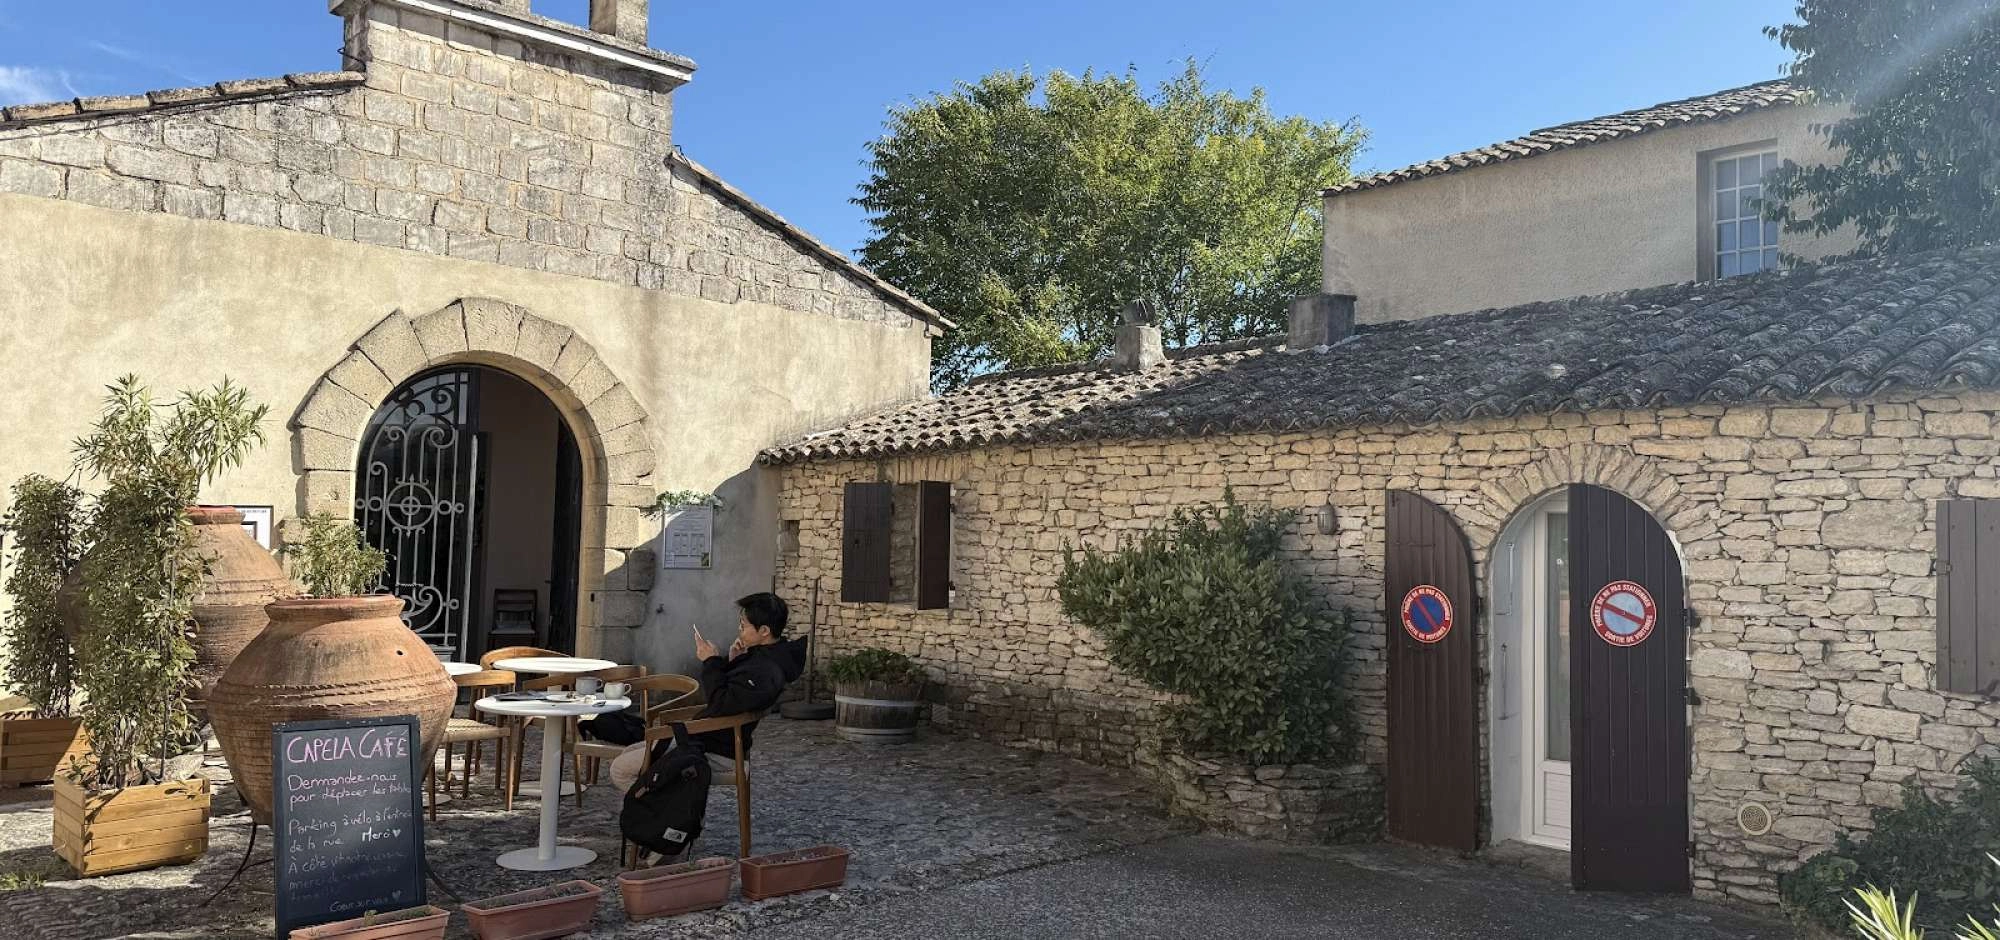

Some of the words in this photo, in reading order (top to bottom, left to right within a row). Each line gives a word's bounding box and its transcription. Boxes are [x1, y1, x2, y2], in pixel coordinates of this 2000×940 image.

[286, 736, 356, 763] CAPELA
[359, 729, 408, 758] CAFÉ
[290, 793, 316, 812] pour
[289, 818, 337, 836] Parking
